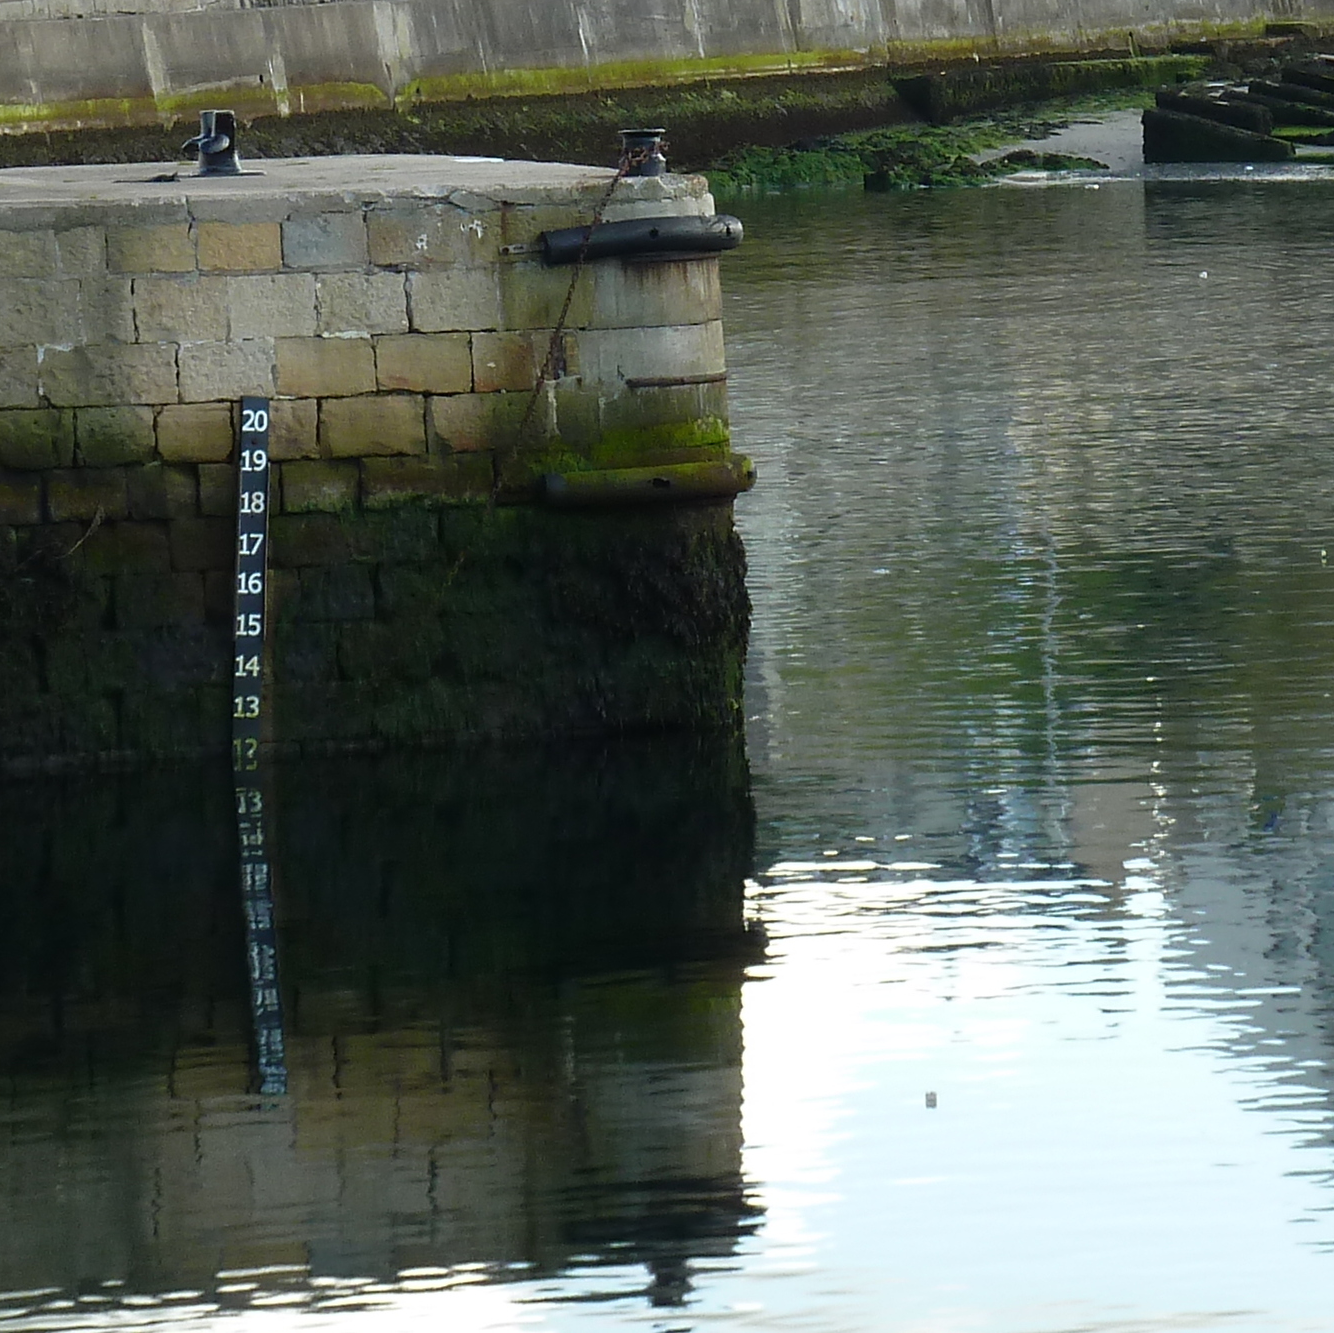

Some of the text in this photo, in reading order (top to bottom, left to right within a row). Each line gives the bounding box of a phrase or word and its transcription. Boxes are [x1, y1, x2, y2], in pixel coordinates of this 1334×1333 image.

[241, 409, 269, 433] 20
[240, 449, 267, 472] 19
[239, 491, 265, 514] 18
[238, 533, 264, 556] 17
[236, 571, 263, 595] 16
[235, 613, 262, 637] 15
[234, 654, 260, 677] 14
[233, 695, 260, 718] 13
